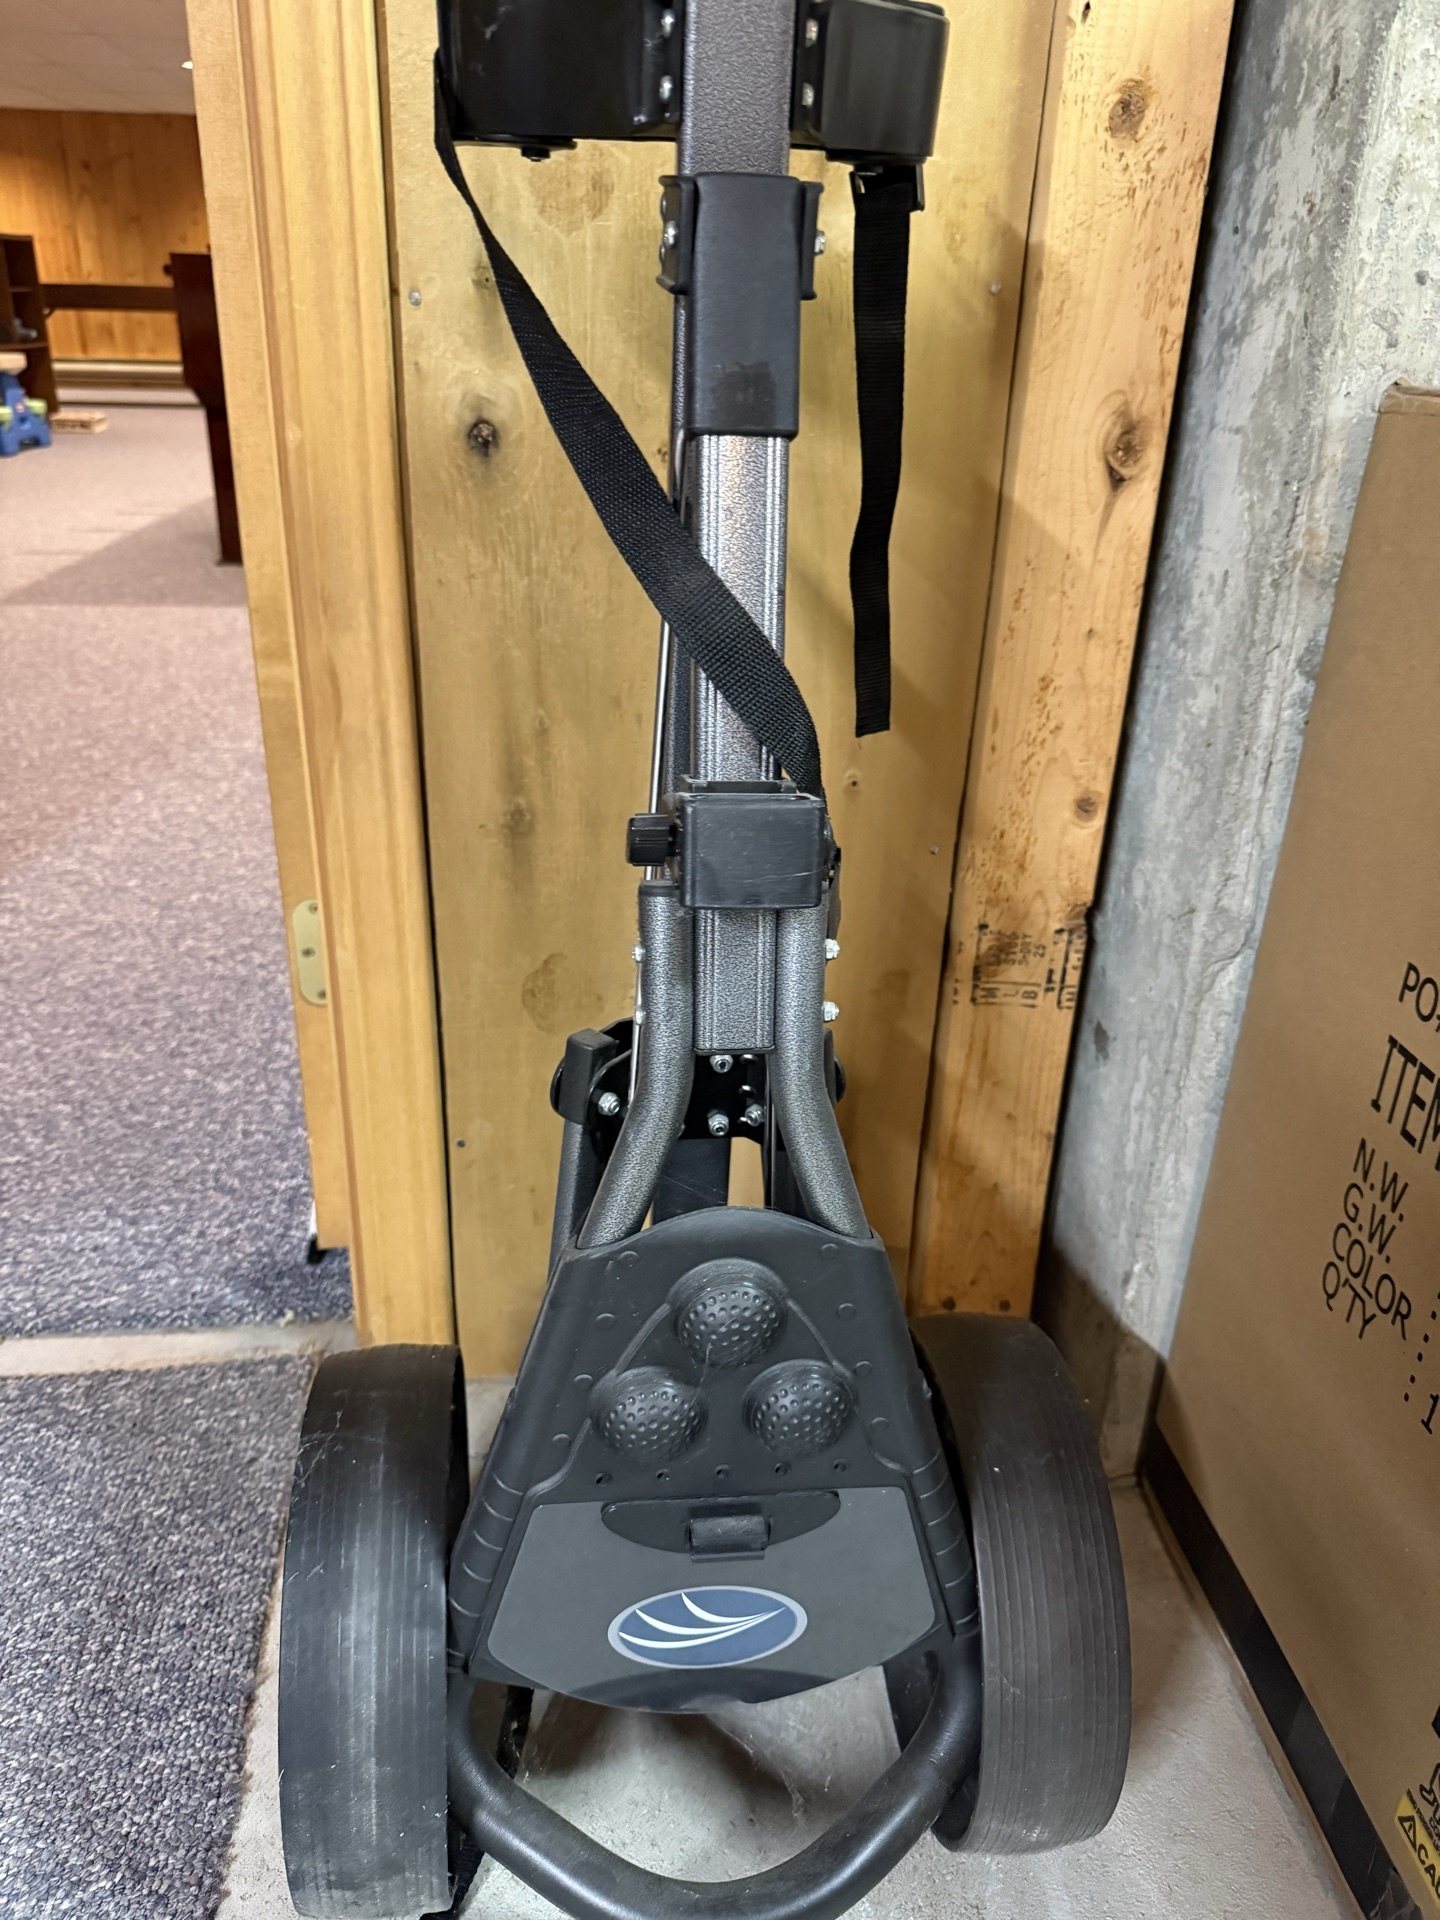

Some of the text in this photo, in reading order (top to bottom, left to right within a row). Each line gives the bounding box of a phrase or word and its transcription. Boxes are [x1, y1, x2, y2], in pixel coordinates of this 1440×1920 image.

[1399, 961, 1440, 1033] PO
[1353, 1137, 1409, 1222] N.W.
[1344, 1182, 1396, 1264] G.W.
[1332, 1222, 1412, 1341] COLOR
